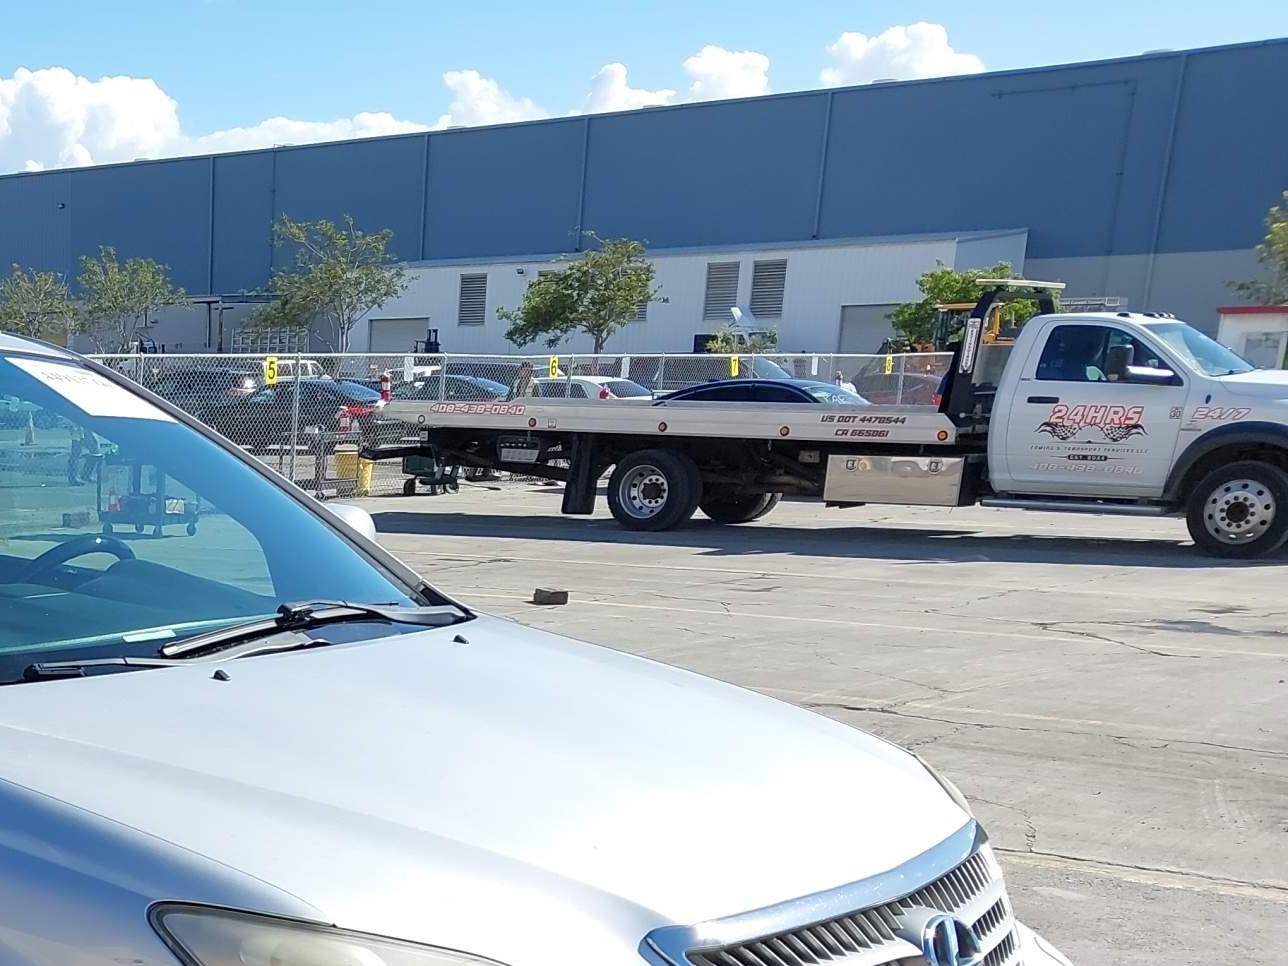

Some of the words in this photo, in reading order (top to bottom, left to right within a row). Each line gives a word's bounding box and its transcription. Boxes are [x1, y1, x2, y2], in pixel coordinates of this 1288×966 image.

[268, 360, 276, 380] 5
[820, 415, 836, 424] US
[837, 415, 859, 424] DOT
[1048, 405, 1144, 425] 24HRS
[1191, 406, 1252, 421] 24/7
[834, 428, 849, 437] CA
